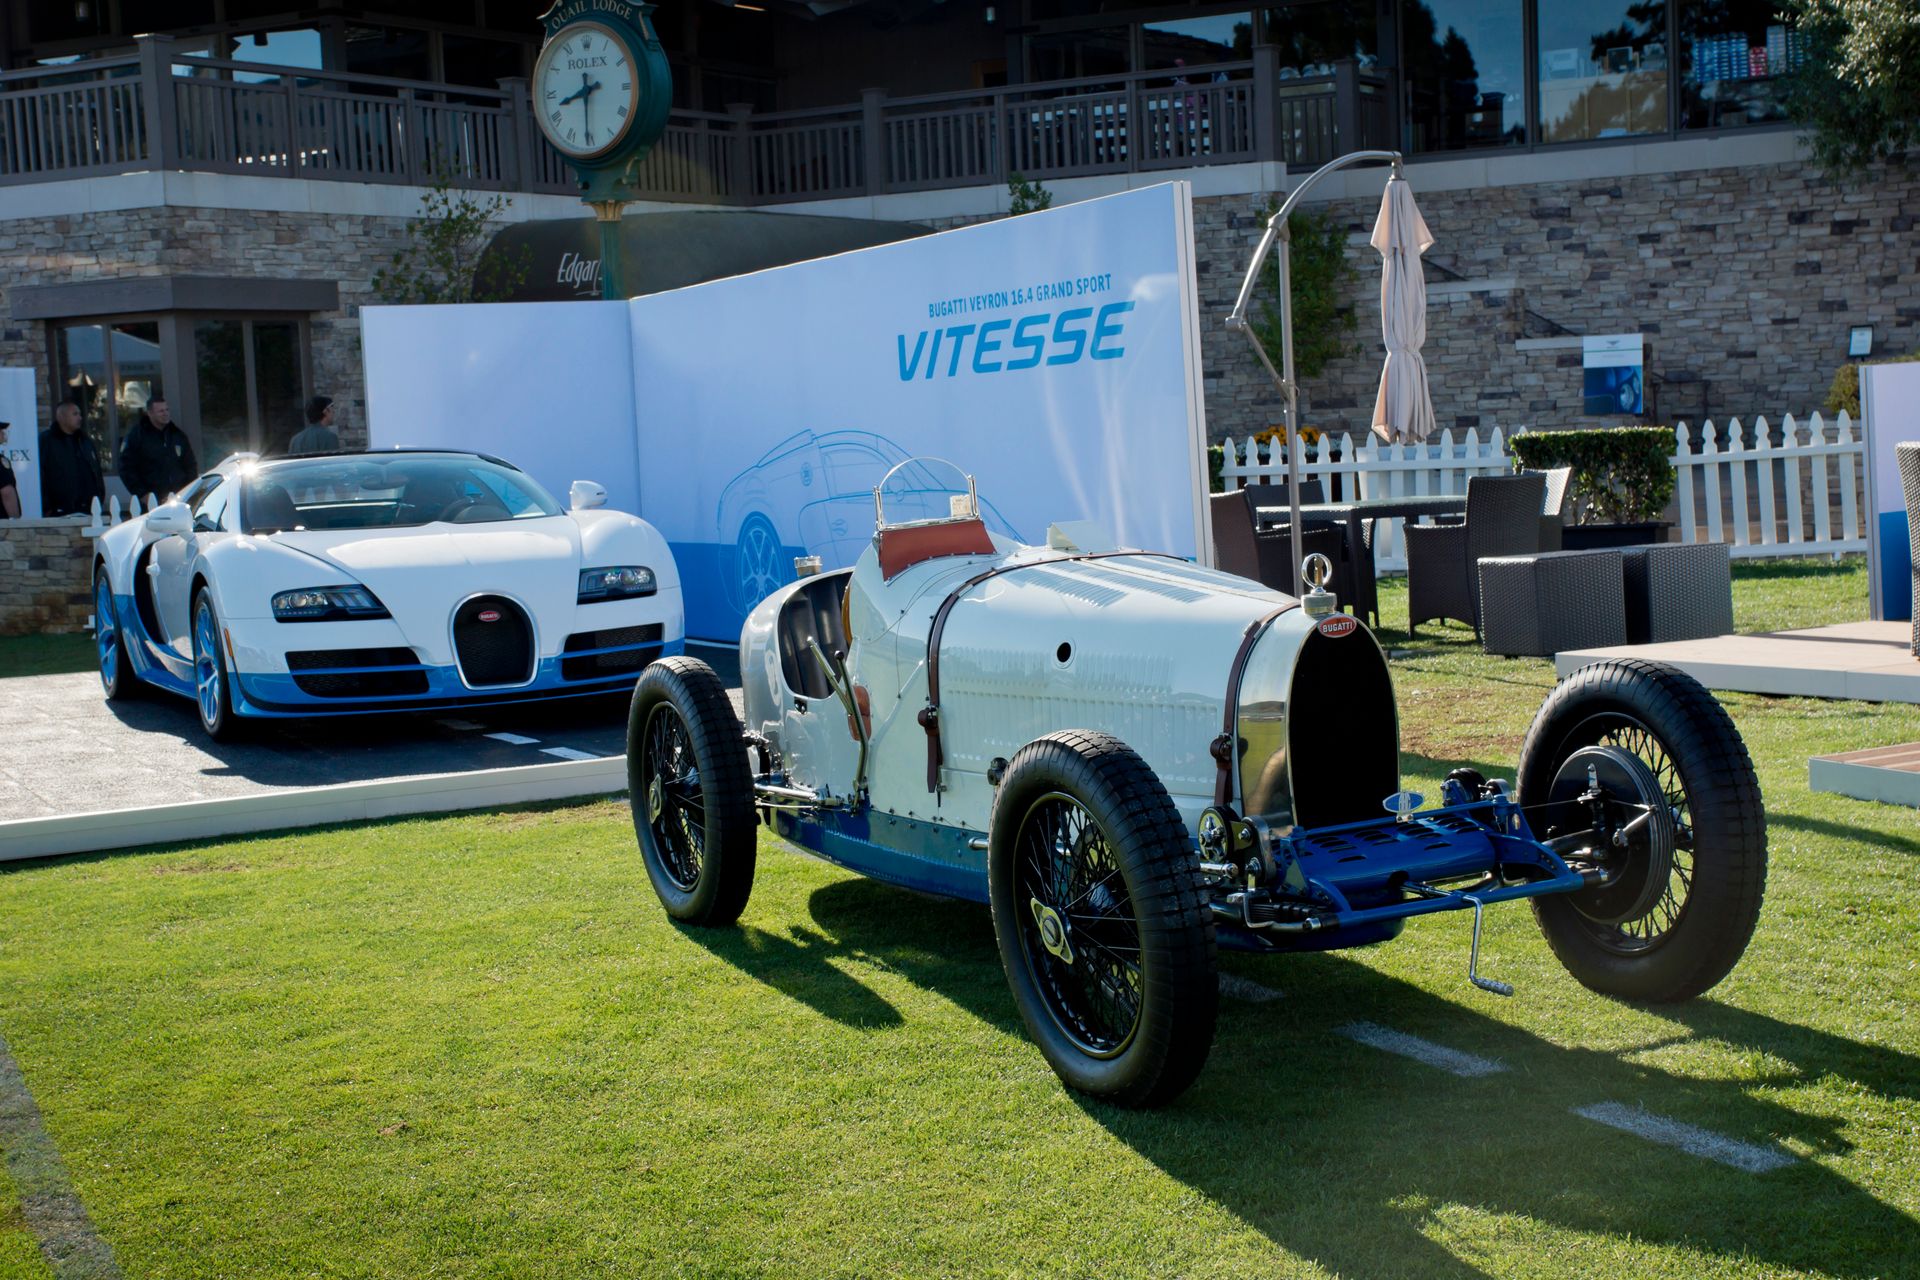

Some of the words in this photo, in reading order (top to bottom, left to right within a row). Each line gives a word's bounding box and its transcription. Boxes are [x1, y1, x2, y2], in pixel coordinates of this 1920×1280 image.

[551, 1, 587, 30] QUAIL
[592, 0, 633, 20] LODGE
[568, 56, 608, 71] ROLEX
[928, 298, 968, 319] BUGATTI
[969, 291, 1008, 312] VEYRON
[1011, 287, 1033, 306] 16.4
[1036, 281, 1073, 301] GRAND
[1077, 273, 1112, 296] SPORT
[897, 300, 1137, 382] VITESSE
[1322, 621, 1353, 633] BUGATTI
